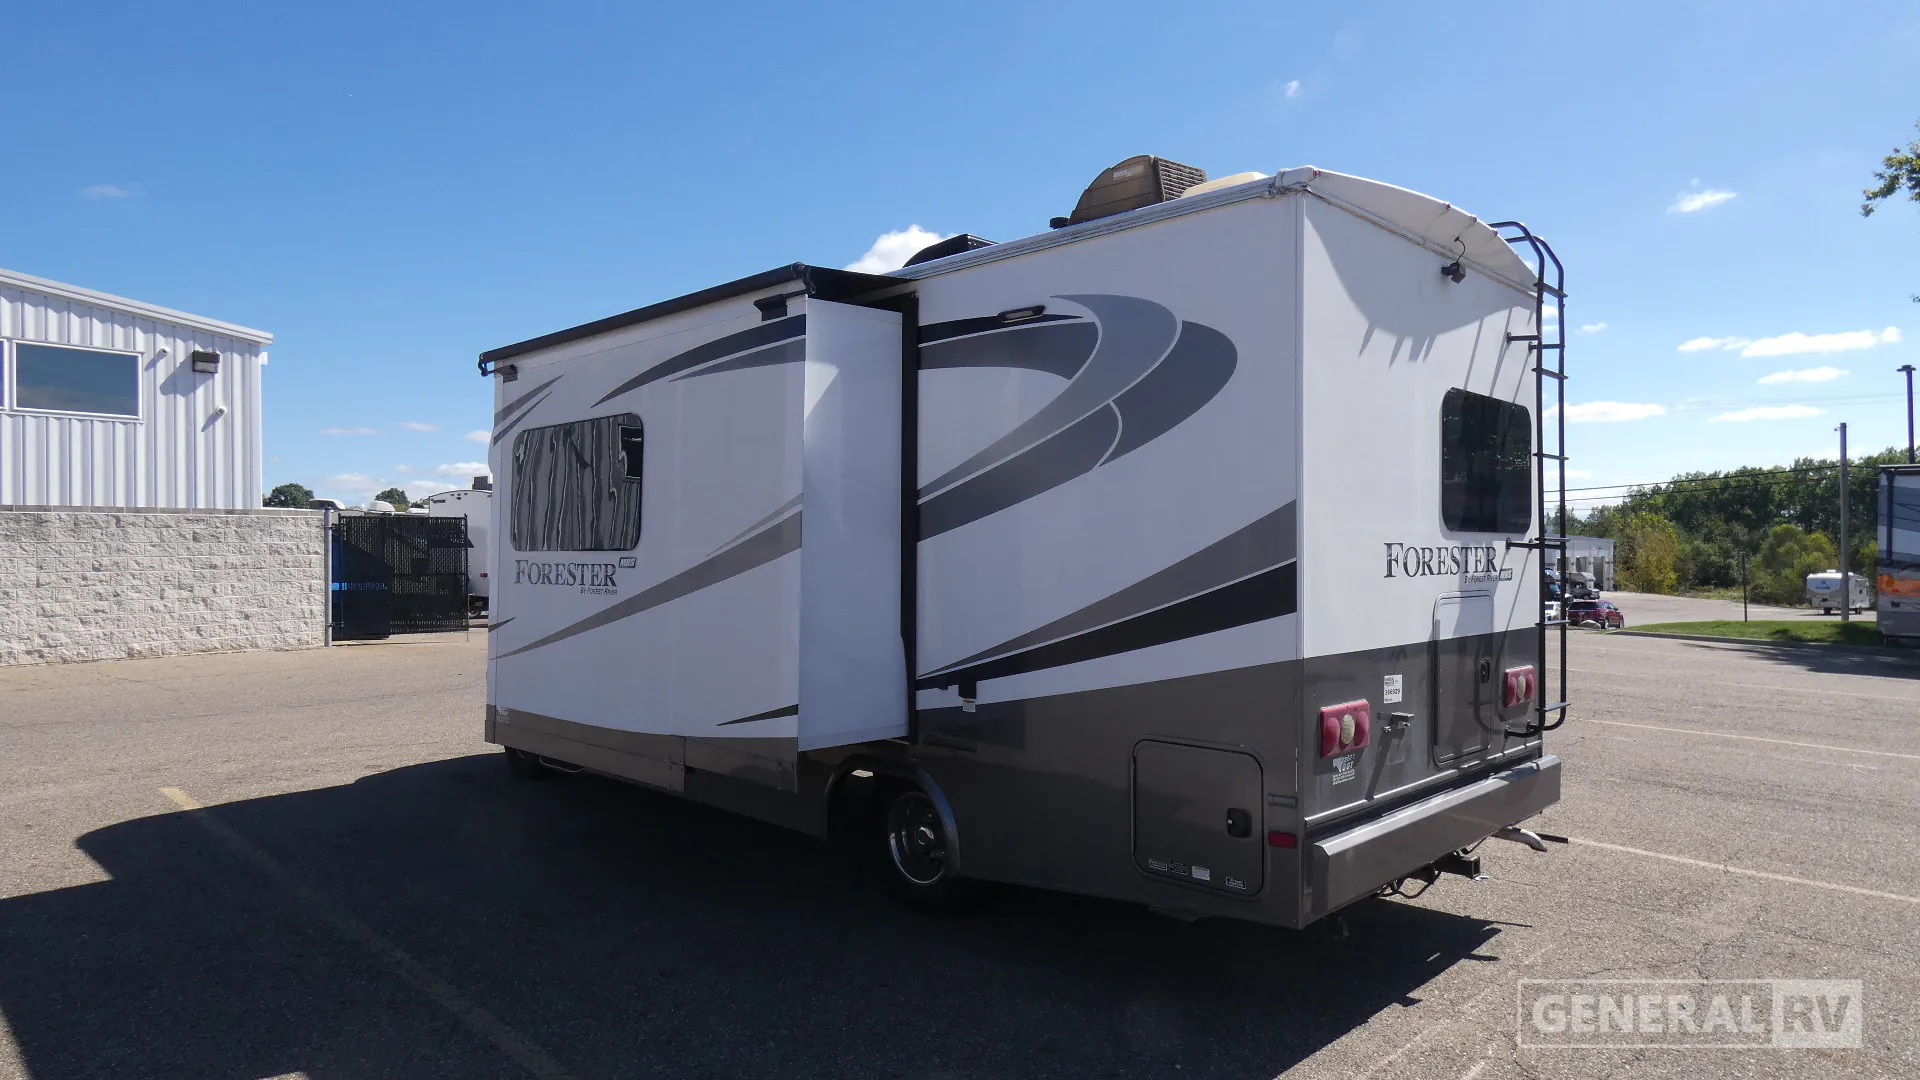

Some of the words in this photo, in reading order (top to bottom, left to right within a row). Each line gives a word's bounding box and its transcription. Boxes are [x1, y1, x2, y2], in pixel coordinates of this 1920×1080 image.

[515, 560, 617, 587] FORESTER
[1384, 543, 1498, 578] FORESTER
[604, 588, 618, 596] RIVER
